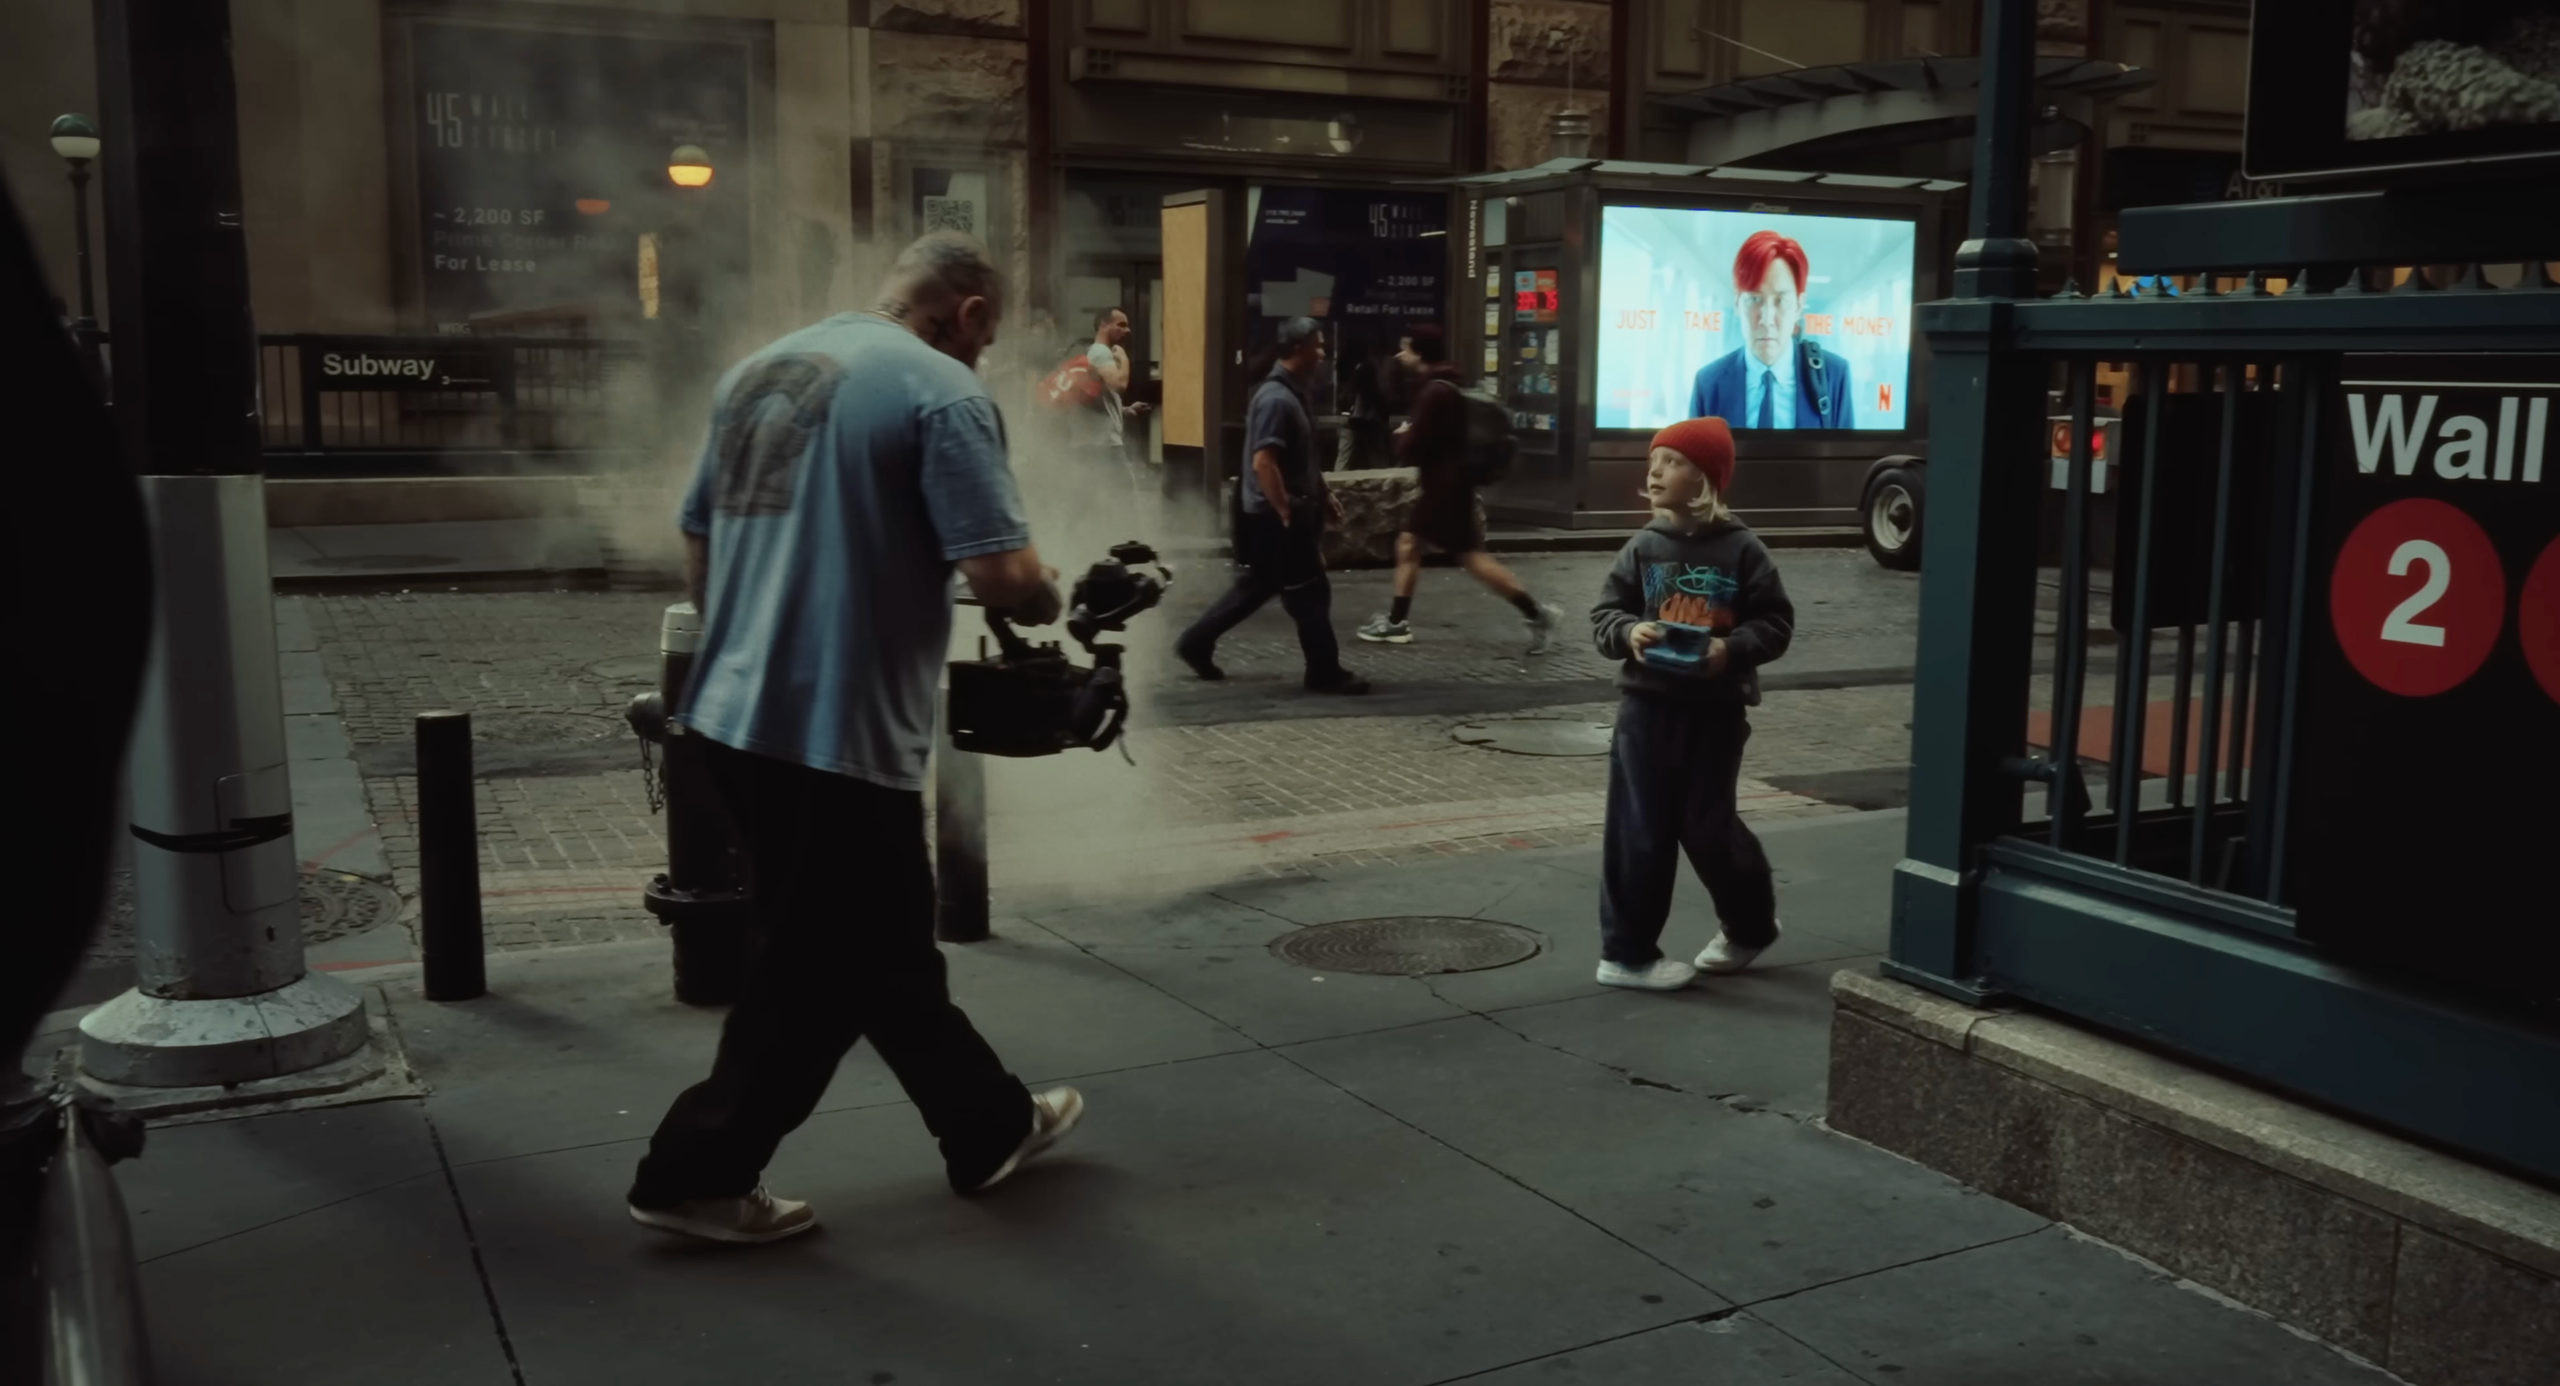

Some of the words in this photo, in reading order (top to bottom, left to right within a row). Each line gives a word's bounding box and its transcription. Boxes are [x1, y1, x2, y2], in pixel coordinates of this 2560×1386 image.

[427, 93, 463, 148] 45
[454, 207, 512, 227] 2,200
[520, 209, 545, 226] SF
[1369, 204, 1388, 238] 45
[434, 254, 468, 271] For
[476, 255, 537, 272] Lease
[1346, 303, 1379, 314] Retail
[1382, 304, 1400, 315] For
[1403, 304, 1435, 315] Lease
[1616, 310, 1657, 330] JUST
[1684, 311, 1722, 332] TAKE
[1804, 313, 1832, 335] THE
[1843, 316, 1896, 337] MONEY
[323, 353, 435, 380] Subway
[1878, 383, 1892, 411] N
[2346, 393, 2549, 483] Wall
[2380, 538, 2451, 648] 2
